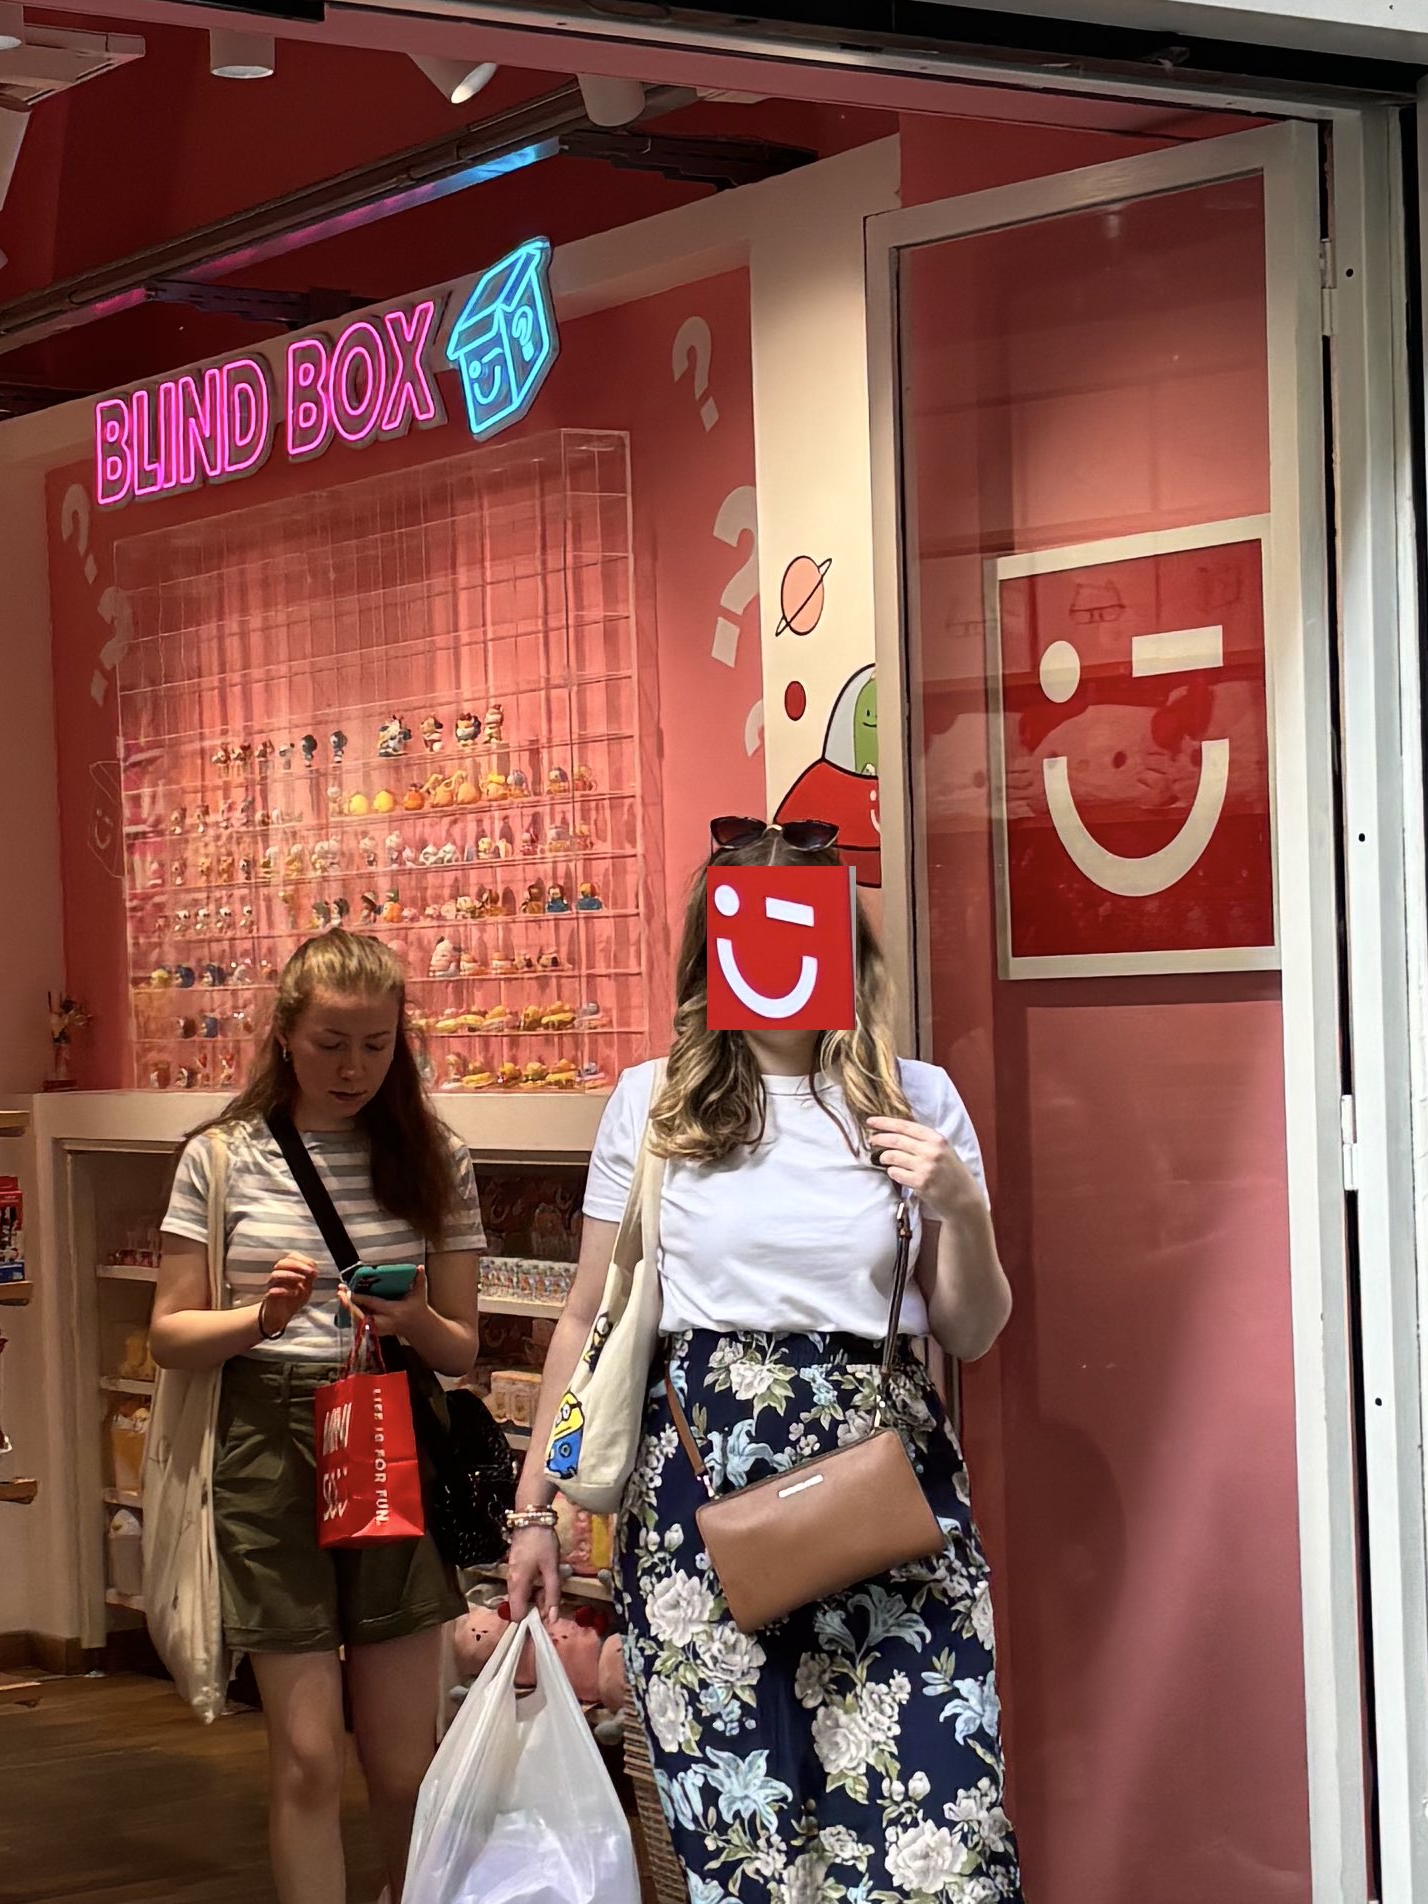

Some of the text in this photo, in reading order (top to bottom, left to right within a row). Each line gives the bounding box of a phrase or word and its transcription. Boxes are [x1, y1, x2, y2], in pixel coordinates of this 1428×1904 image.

[95, 300, 437, 506] BLIND BOX
[374, 1449, 388, 1483] FOR
